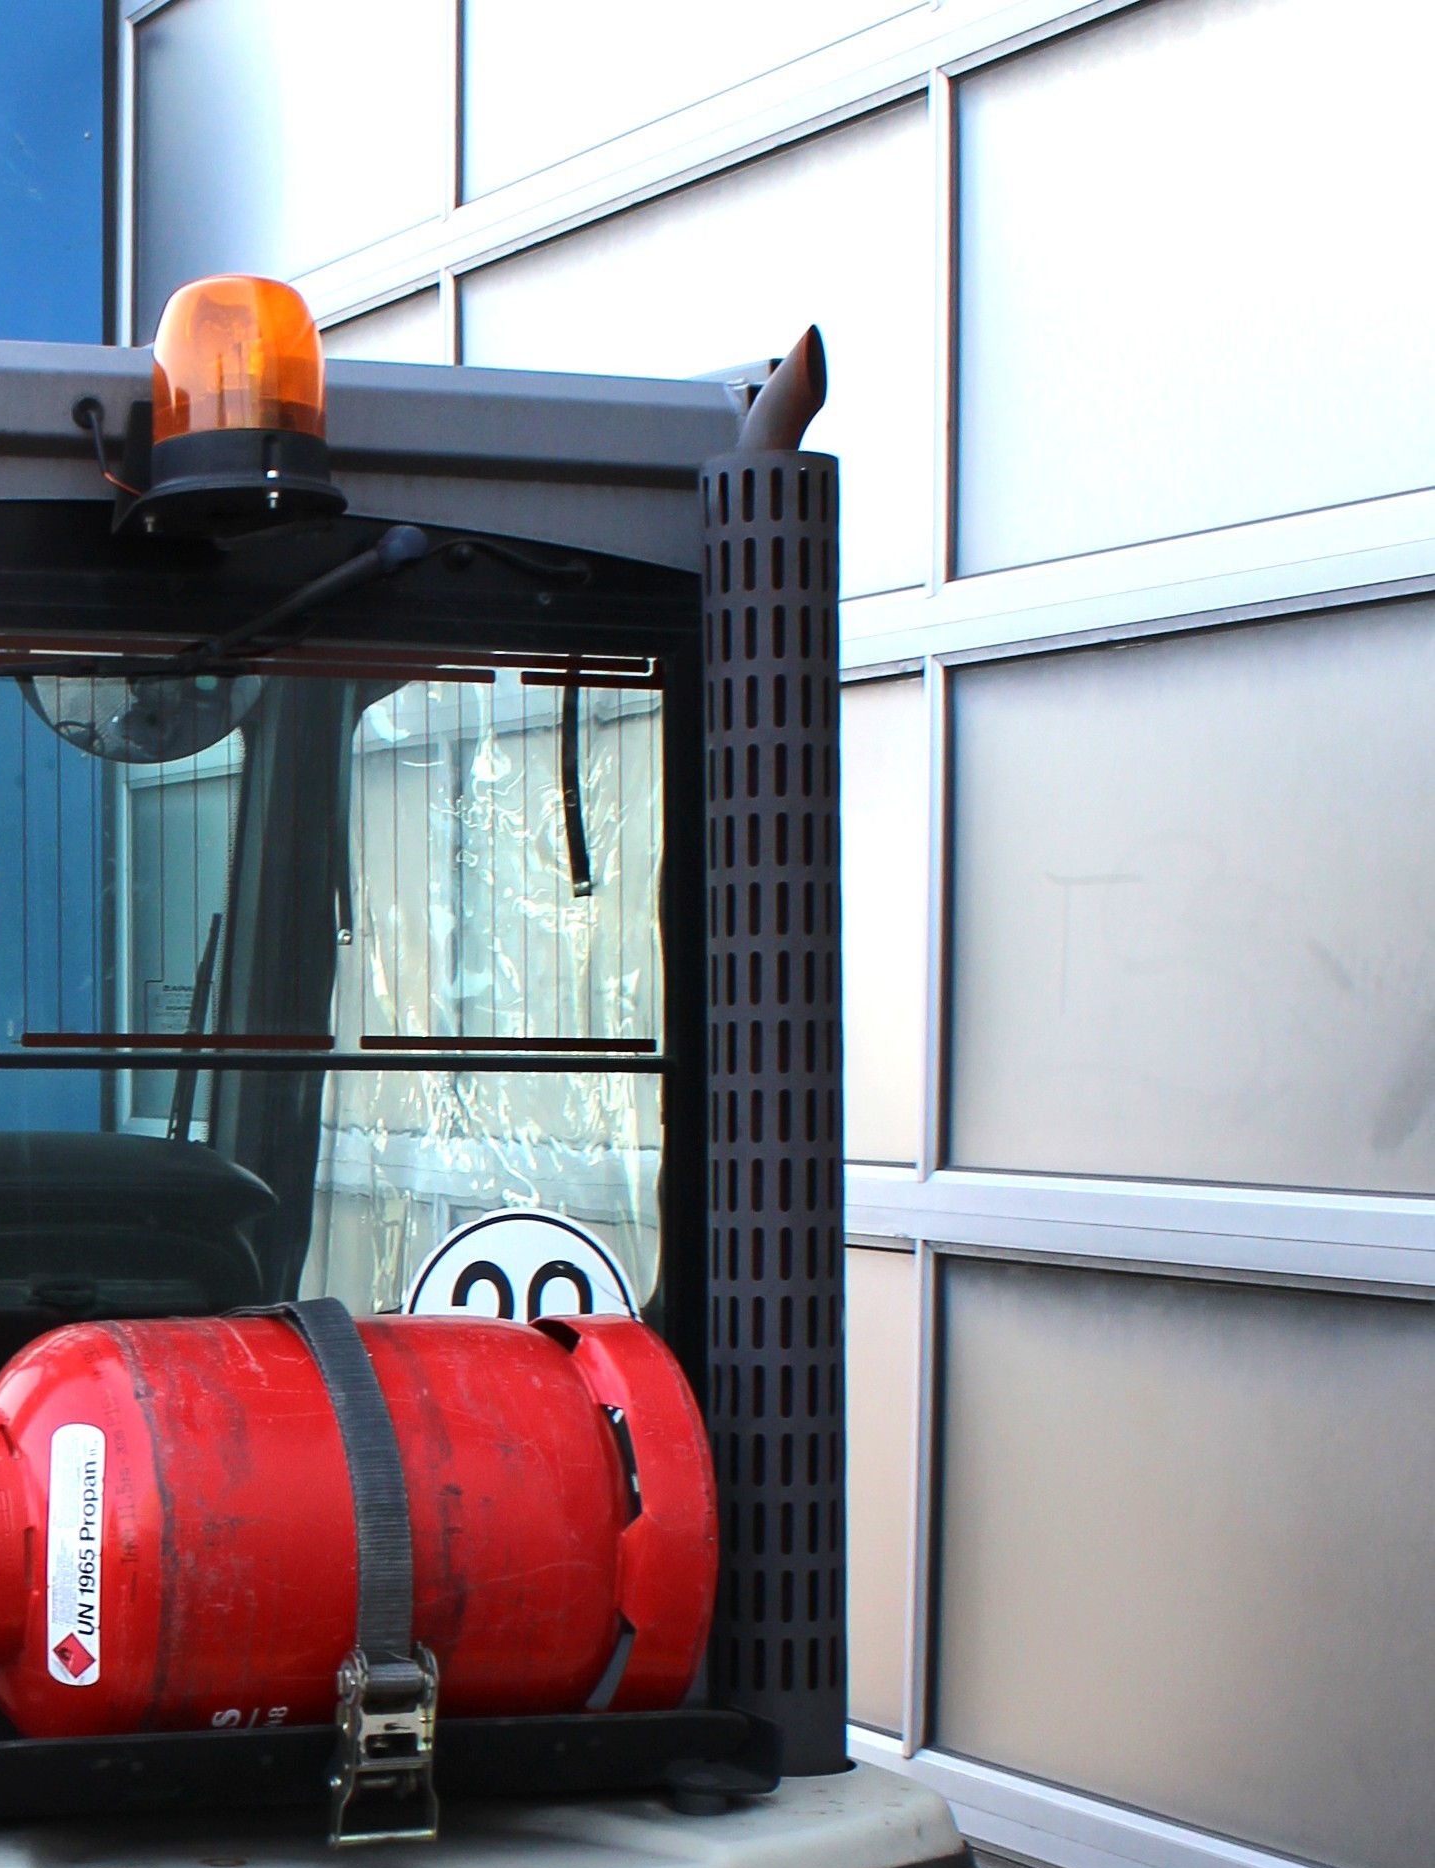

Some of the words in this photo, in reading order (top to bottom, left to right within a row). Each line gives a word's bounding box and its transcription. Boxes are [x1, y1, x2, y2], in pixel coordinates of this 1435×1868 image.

[79, 1459, 98, 1542] Propan
[78, 1549, 96, 1595] 1965
[77, 1602, 95, 1636] UN
